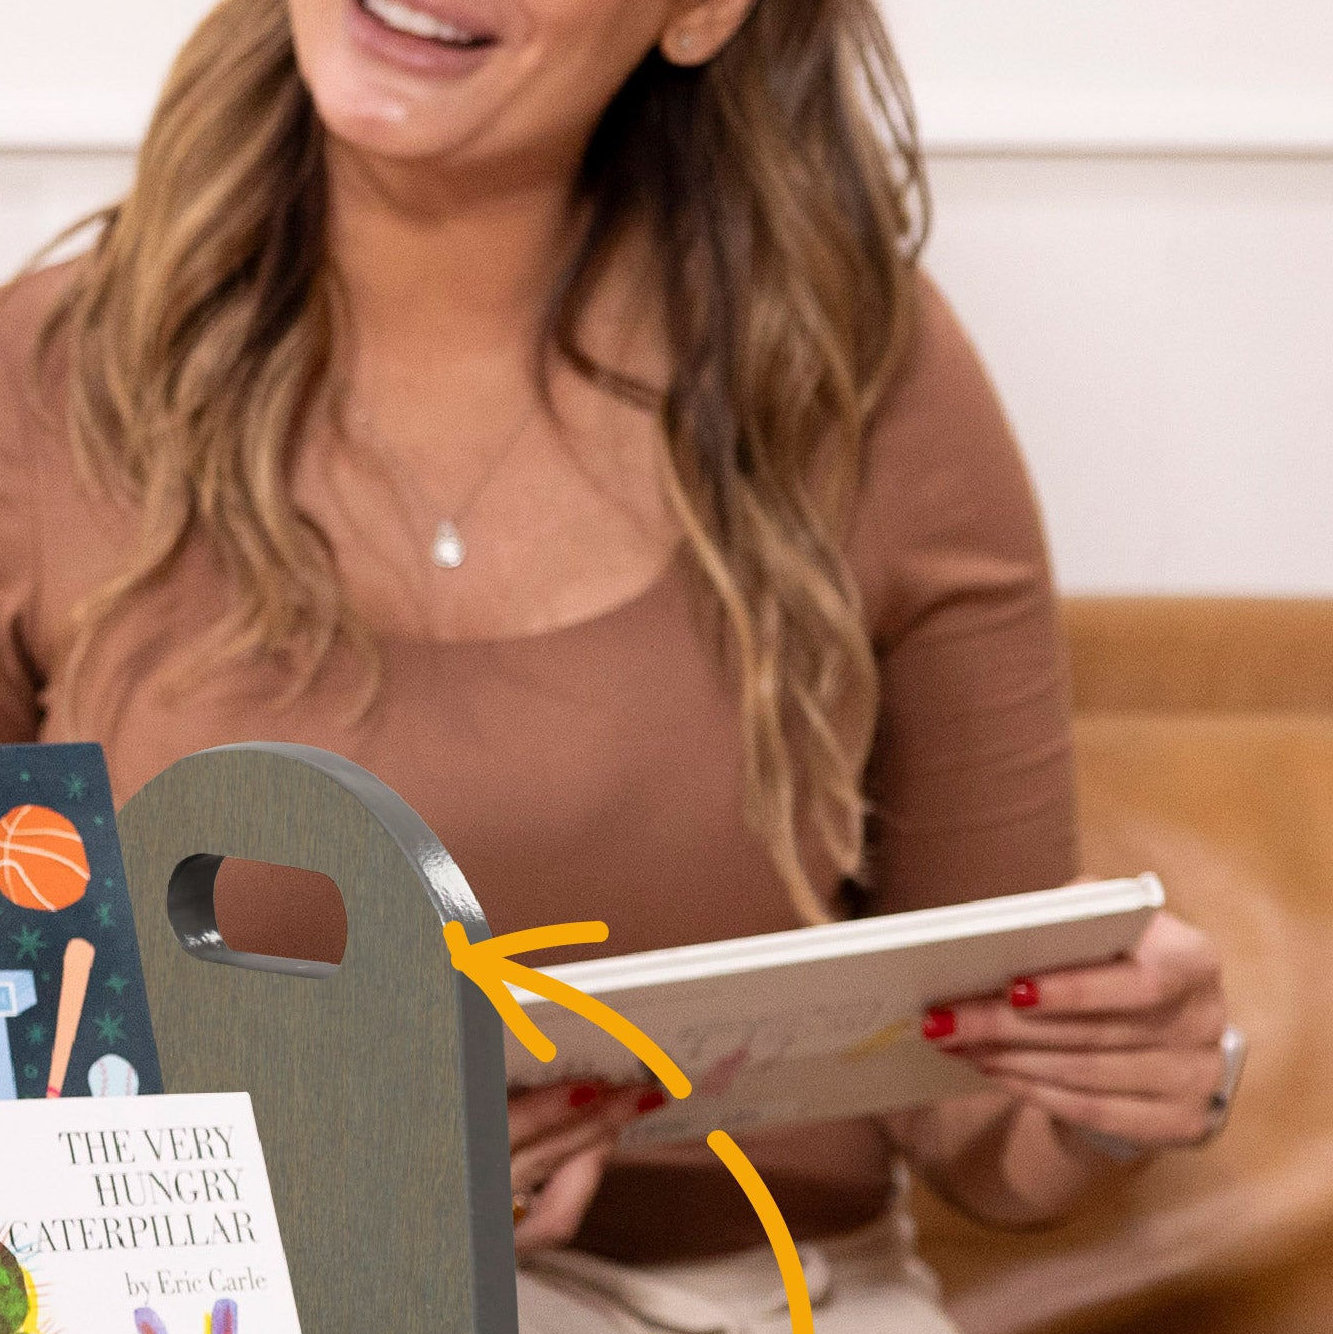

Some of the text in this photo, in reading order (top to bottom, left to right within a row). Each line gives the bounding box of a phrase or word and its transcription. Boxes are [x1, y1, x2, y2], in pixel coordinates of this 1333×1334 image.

[58, 1125, 235, 1166] THE VERY
[93, 1169, 244, 1208] HUNGRY
[8, 1210, 259, 1254] CATERPILLAR
[127, 1267, 269, 1306] by Eric Carle
